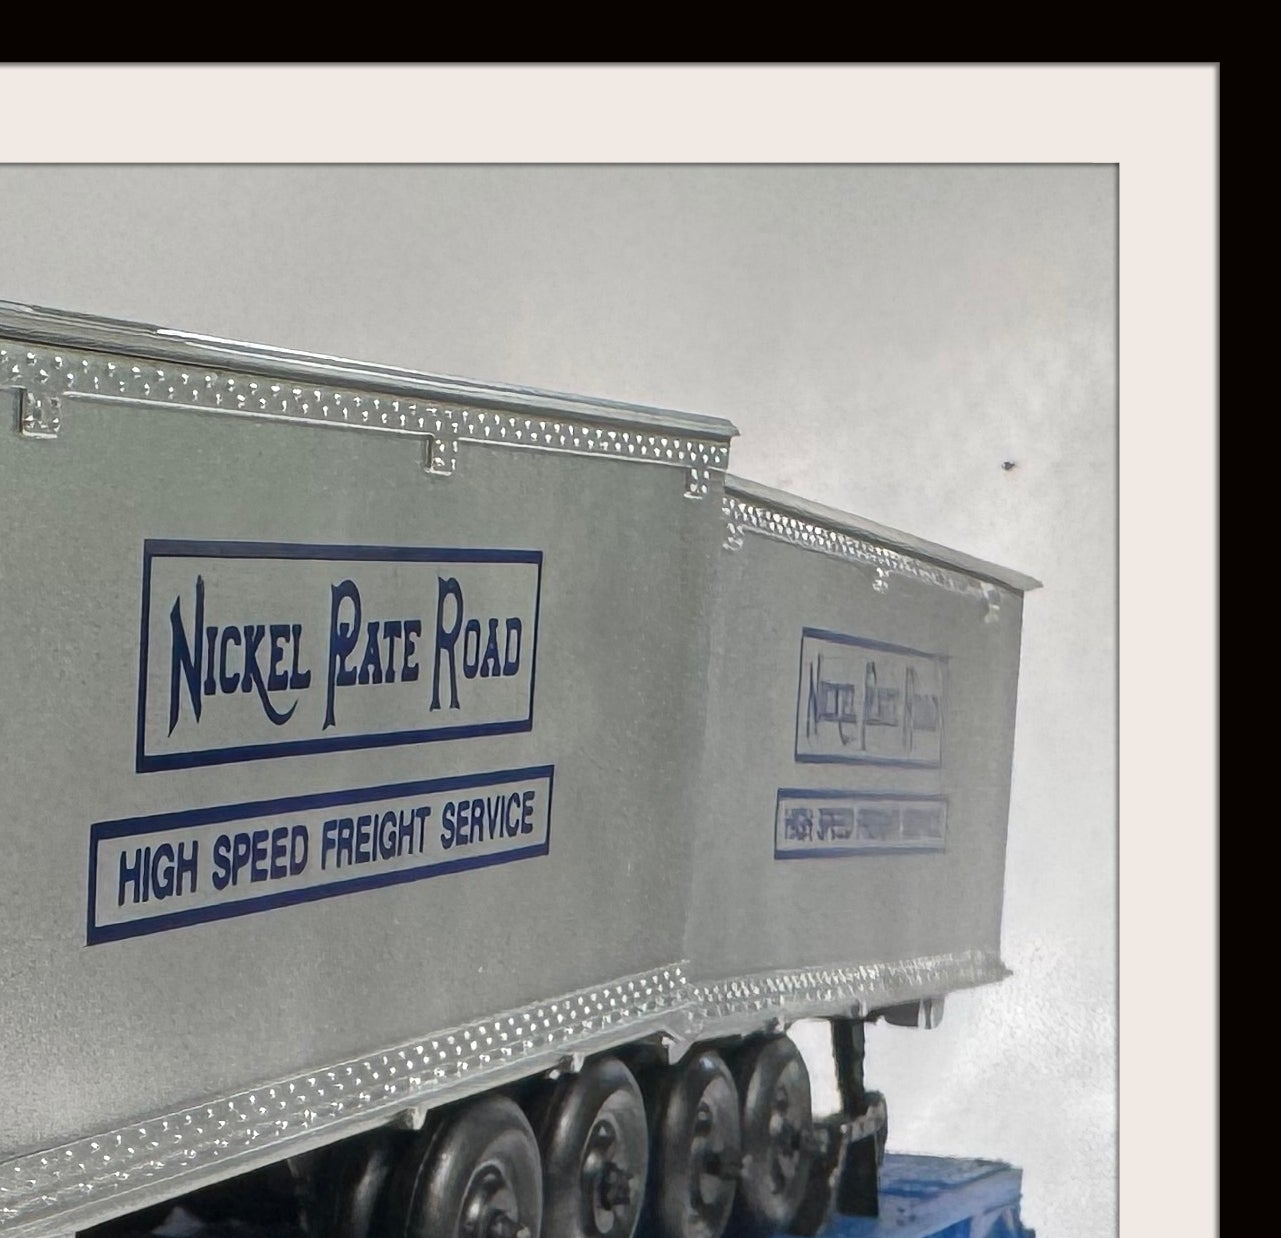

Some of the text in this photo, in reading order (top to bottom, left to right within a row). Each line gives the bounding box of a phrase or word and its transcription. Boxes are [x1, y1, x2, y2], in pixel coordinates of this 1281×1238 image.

[167, 574, 312, 738] NICKEL
[428, 575, 523, 712] ROAD
[118, 790, 536, 907] HIGH SPEED FREIGHT SERVICE
